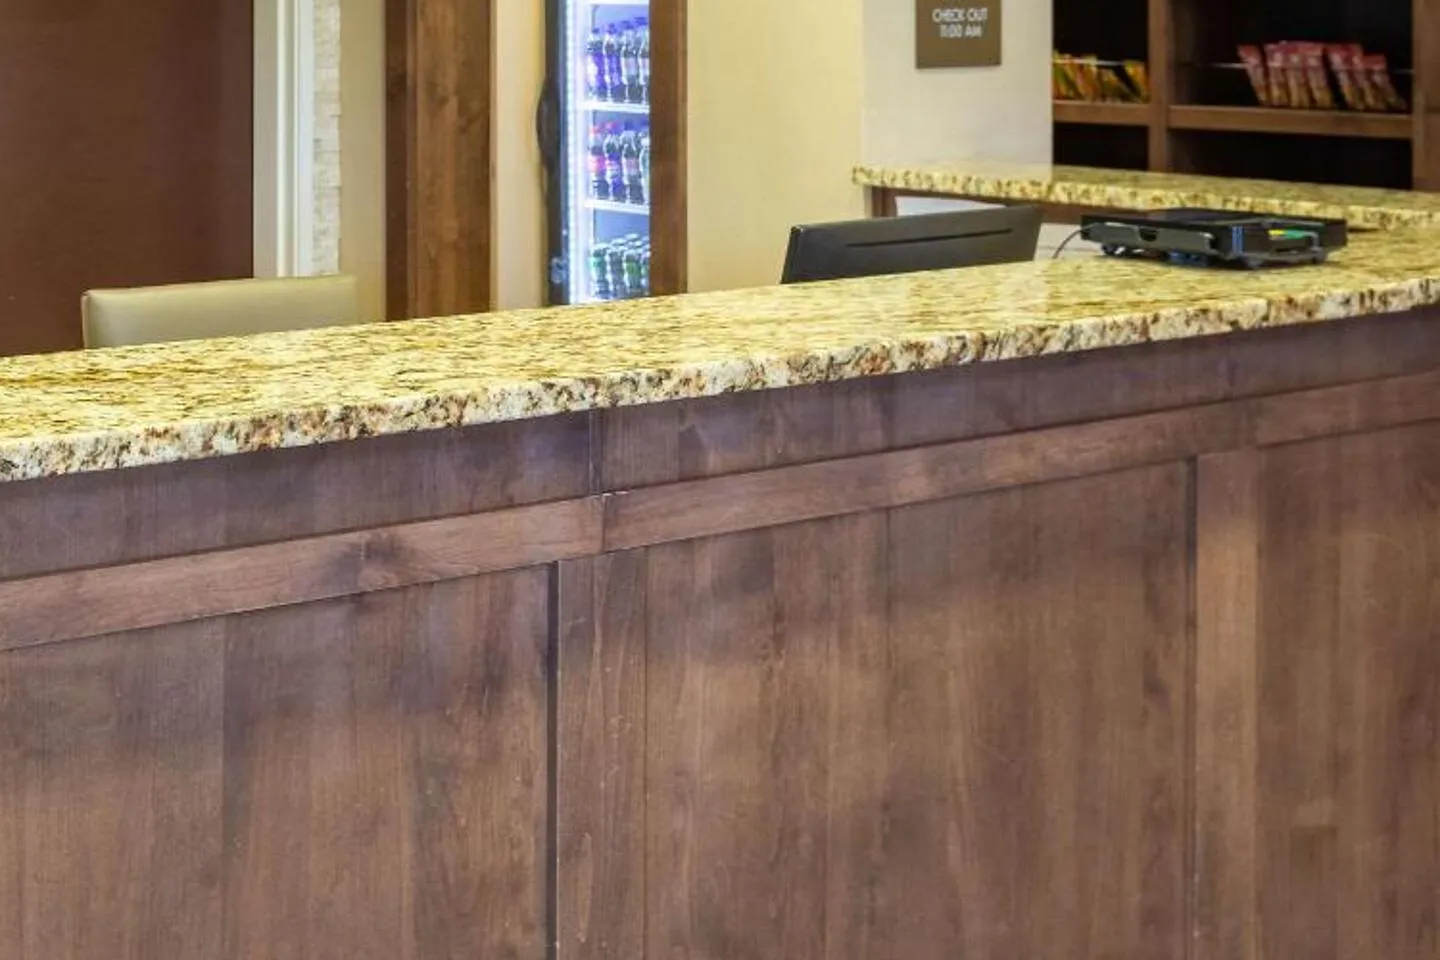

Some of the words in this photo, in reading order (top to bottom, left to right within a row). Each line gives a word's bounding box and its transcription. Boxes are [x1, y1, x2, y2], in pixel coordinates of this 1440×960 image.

[932, 8, 965, 23] CHECK
[967, 7, 989, 22] OUT
[965, 24, 982, 37] AM
